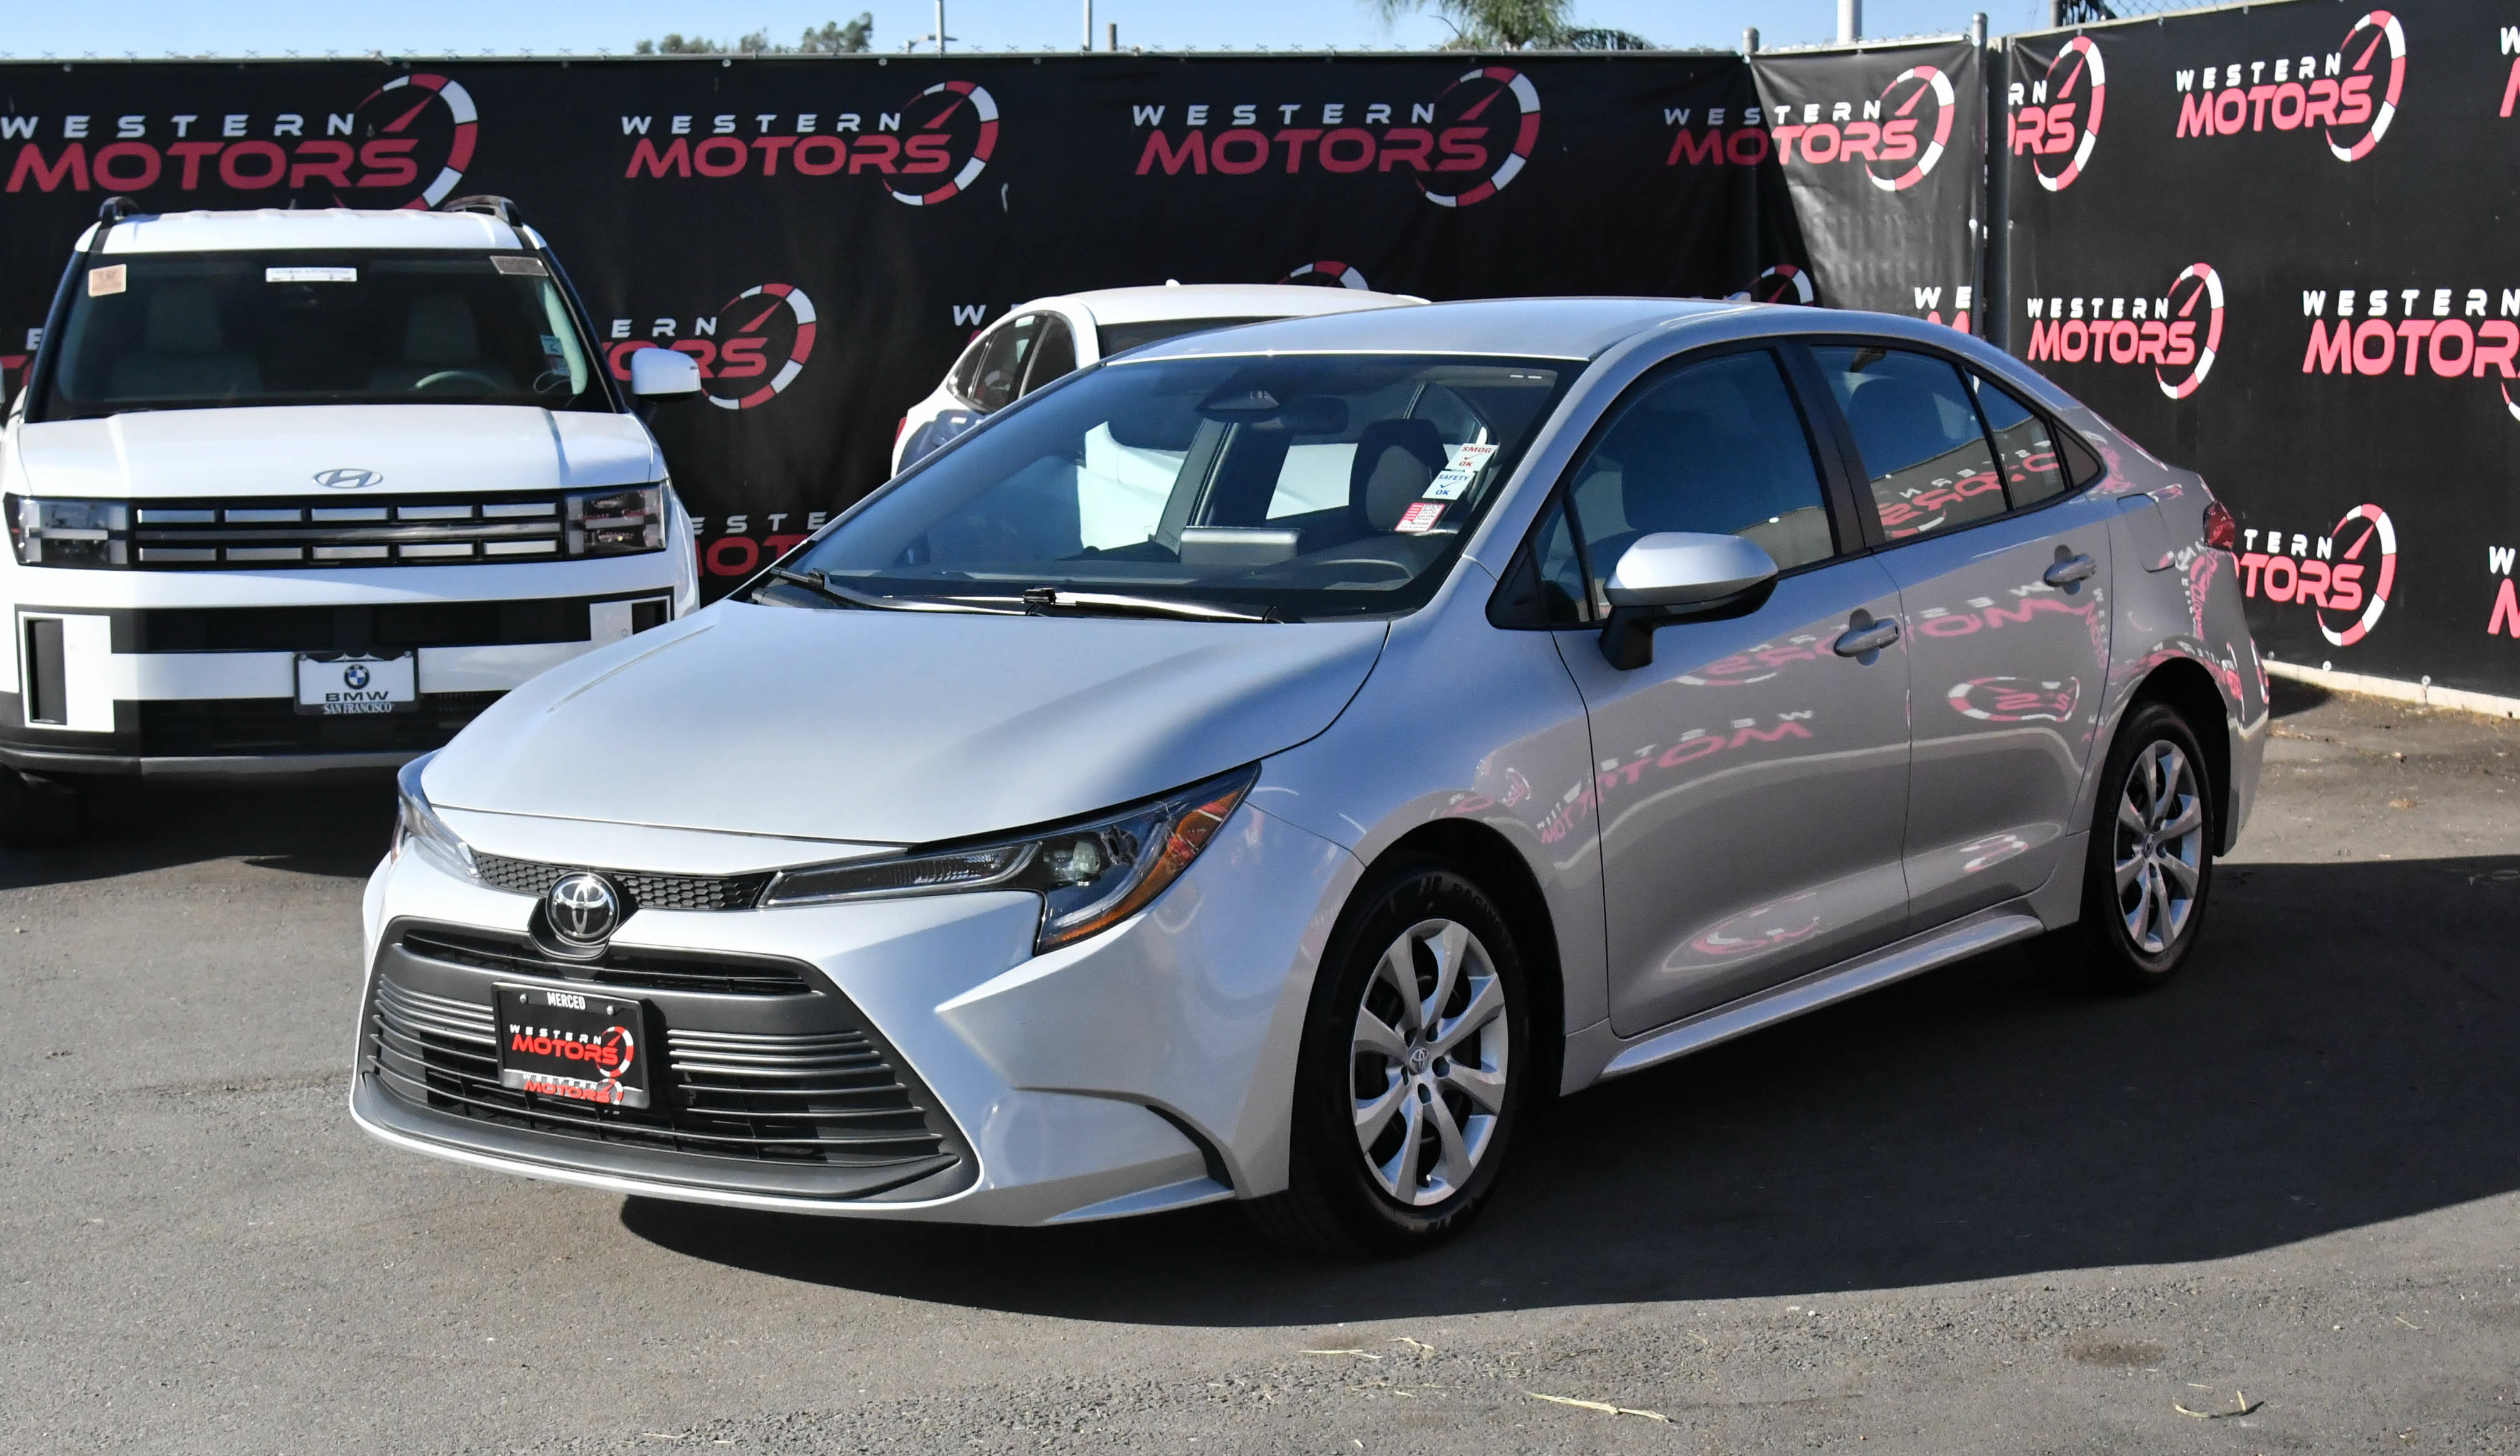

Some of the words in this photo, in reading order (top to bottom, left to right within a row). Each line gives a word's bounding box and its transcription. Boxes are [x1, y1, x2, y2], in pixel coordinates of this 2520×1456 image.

[2176, 53, 2341, 92] WESTERN
[1133, 104, 1434, 126] WESTERN
[1665, 100, 1881, 125] WESTERN
[2176, 75, 2374, 138] MOTORS
[1, 114, 354, 139] WESTERN
[622, 113, 900, 135] WESTERN
[1136, 127, 1489, 175] MOTORS
[1667, 119, 1918, 165] MOTORS
[6, 139, 419, 193] MOTORS
[625, 134, 951, 178] MOTORS
[2027, 297, 2169, 319] WESTERN
[2303, 289, 2520, 317] WESTERN
[2027, 319, 2197, 365] MOTORS
[2302, 318, 2520, 378] MOTOR
[323, 703, 343, 715] SAN
[344, 702, 392, 714] FRANCISCO
[325, 691, 389, 702] BMW
[547, 992, 586, 1010] MERCED
[510, 1024, 602, 1045] WESTERN
[512, 1033, 619, 1065] MOTORS
[523, 1073, 597, 1090] WESTERN
[524, 1080, 611, 1103] MOTORS
